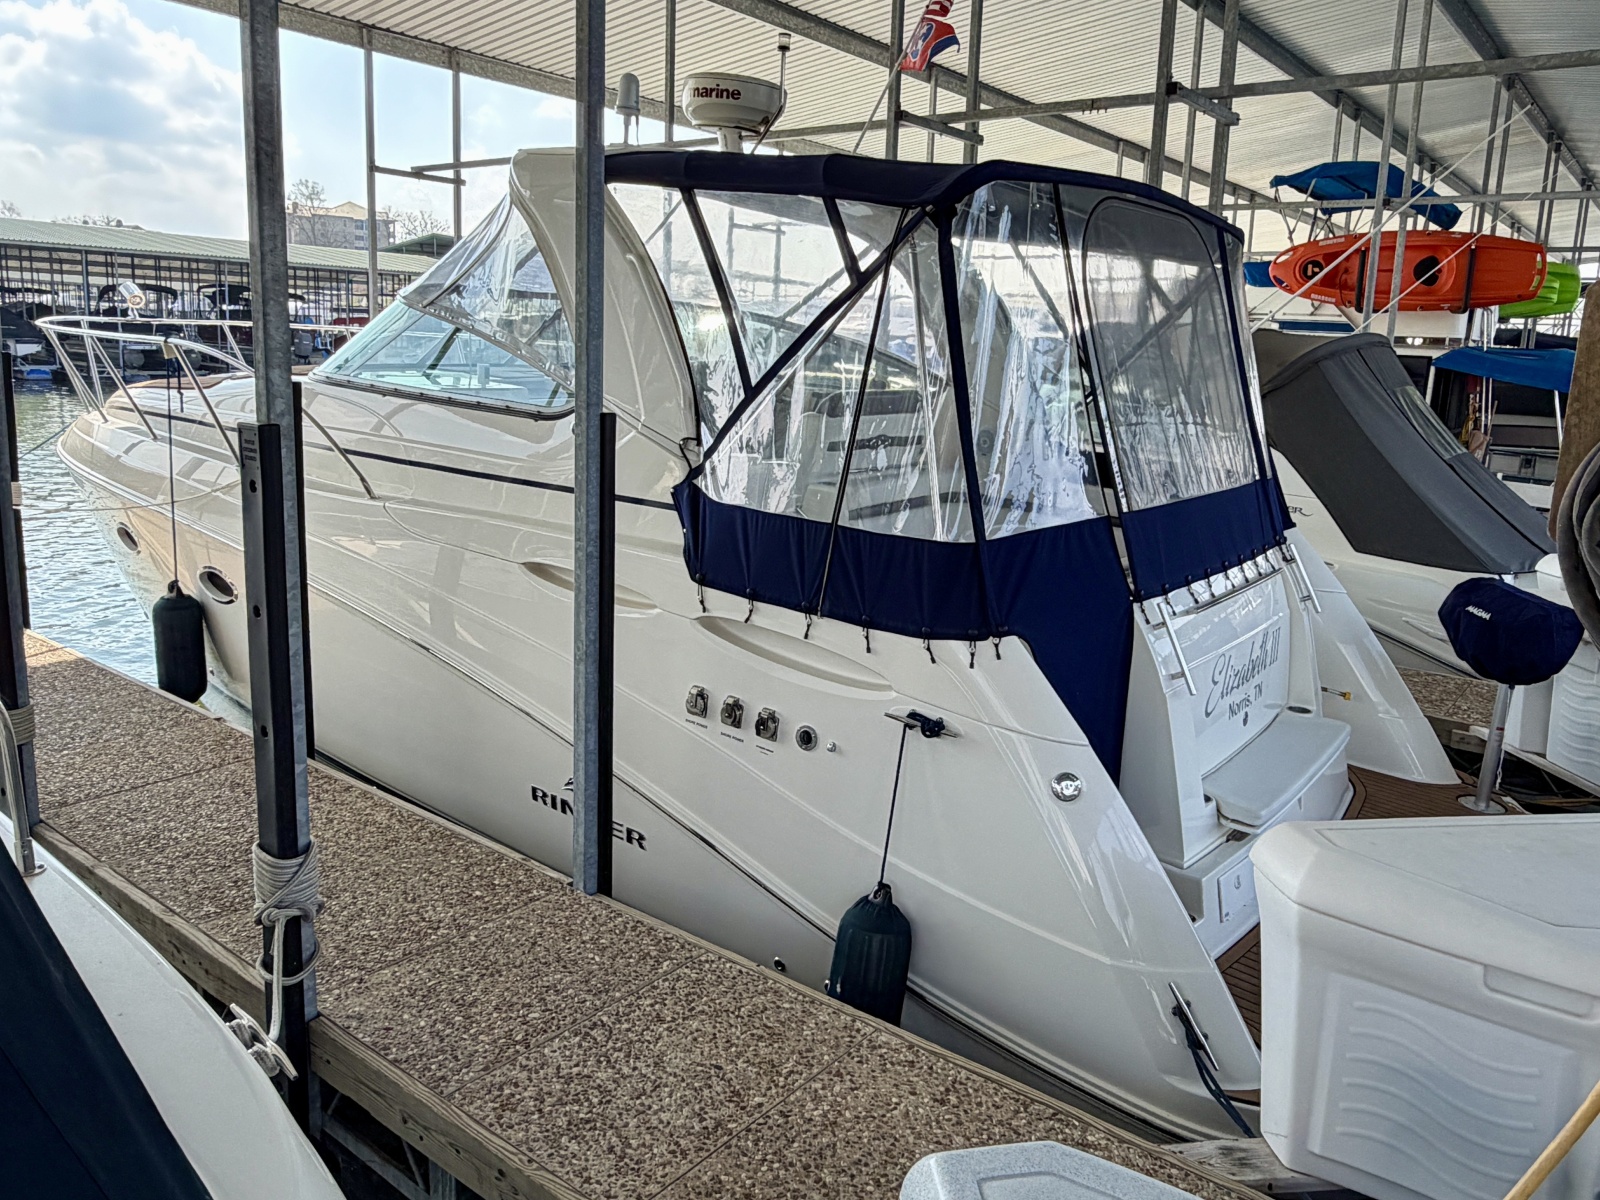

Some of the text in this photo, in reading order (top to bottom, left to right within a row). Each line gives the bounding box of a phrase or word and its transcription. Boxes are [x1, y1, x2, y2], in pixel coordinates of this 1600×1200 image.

[1465, 605, 1492, 620] MAGMA
[1205, 630, 1270, 719] Elizabeth
[1254, 681, 1263, 701] TN
[531, 785, 647, 851] RINER
